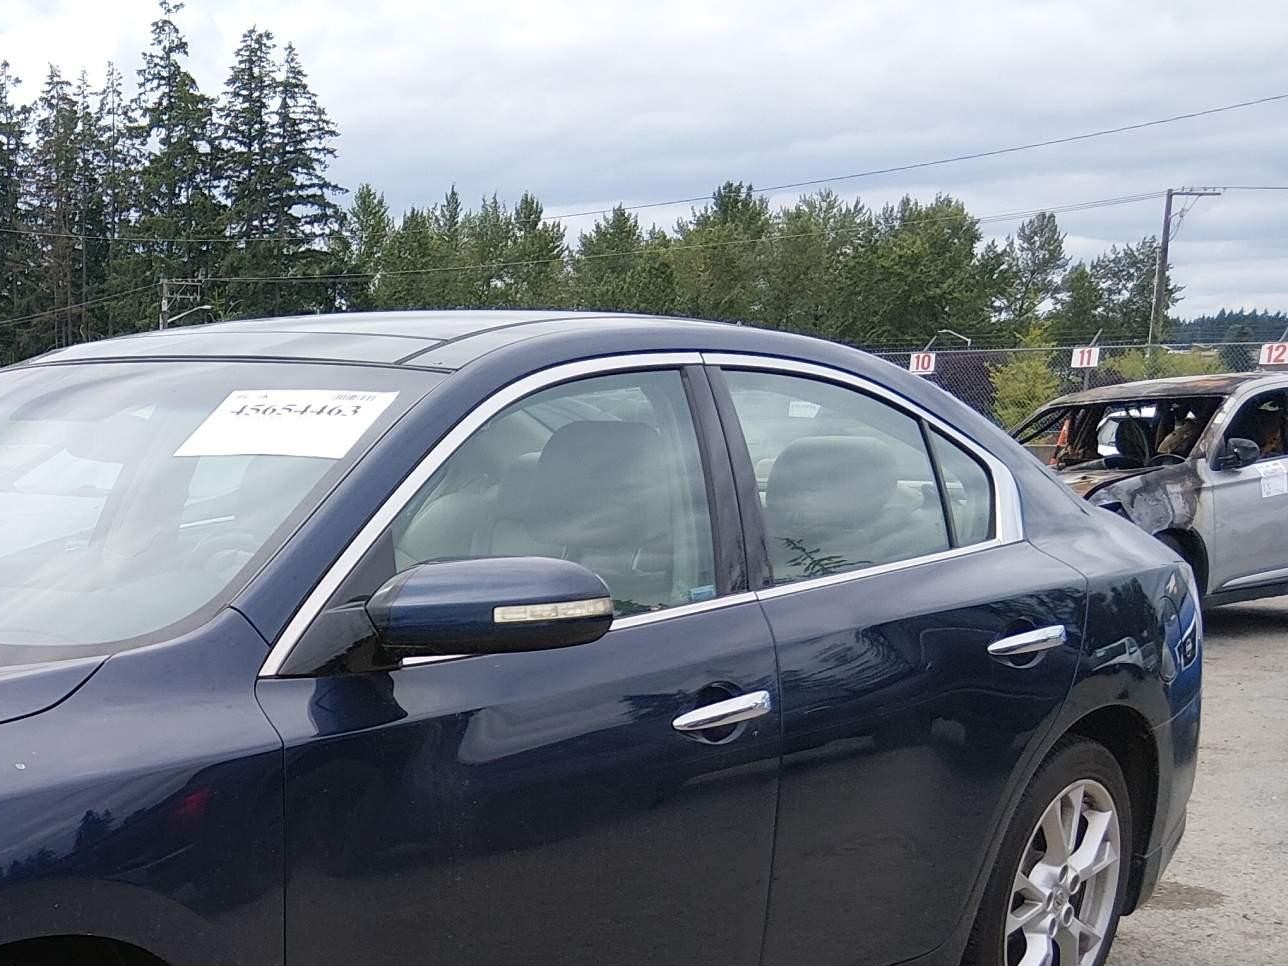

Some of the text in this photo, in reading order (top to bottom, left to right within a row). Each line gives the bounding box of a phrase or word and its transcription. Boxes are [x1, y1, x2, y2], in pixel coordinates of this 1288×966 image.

[914, 354, 931, 370] 10
[1079, 349, 1092, 366] 11
[1266, 344, 1287, 363] 12
